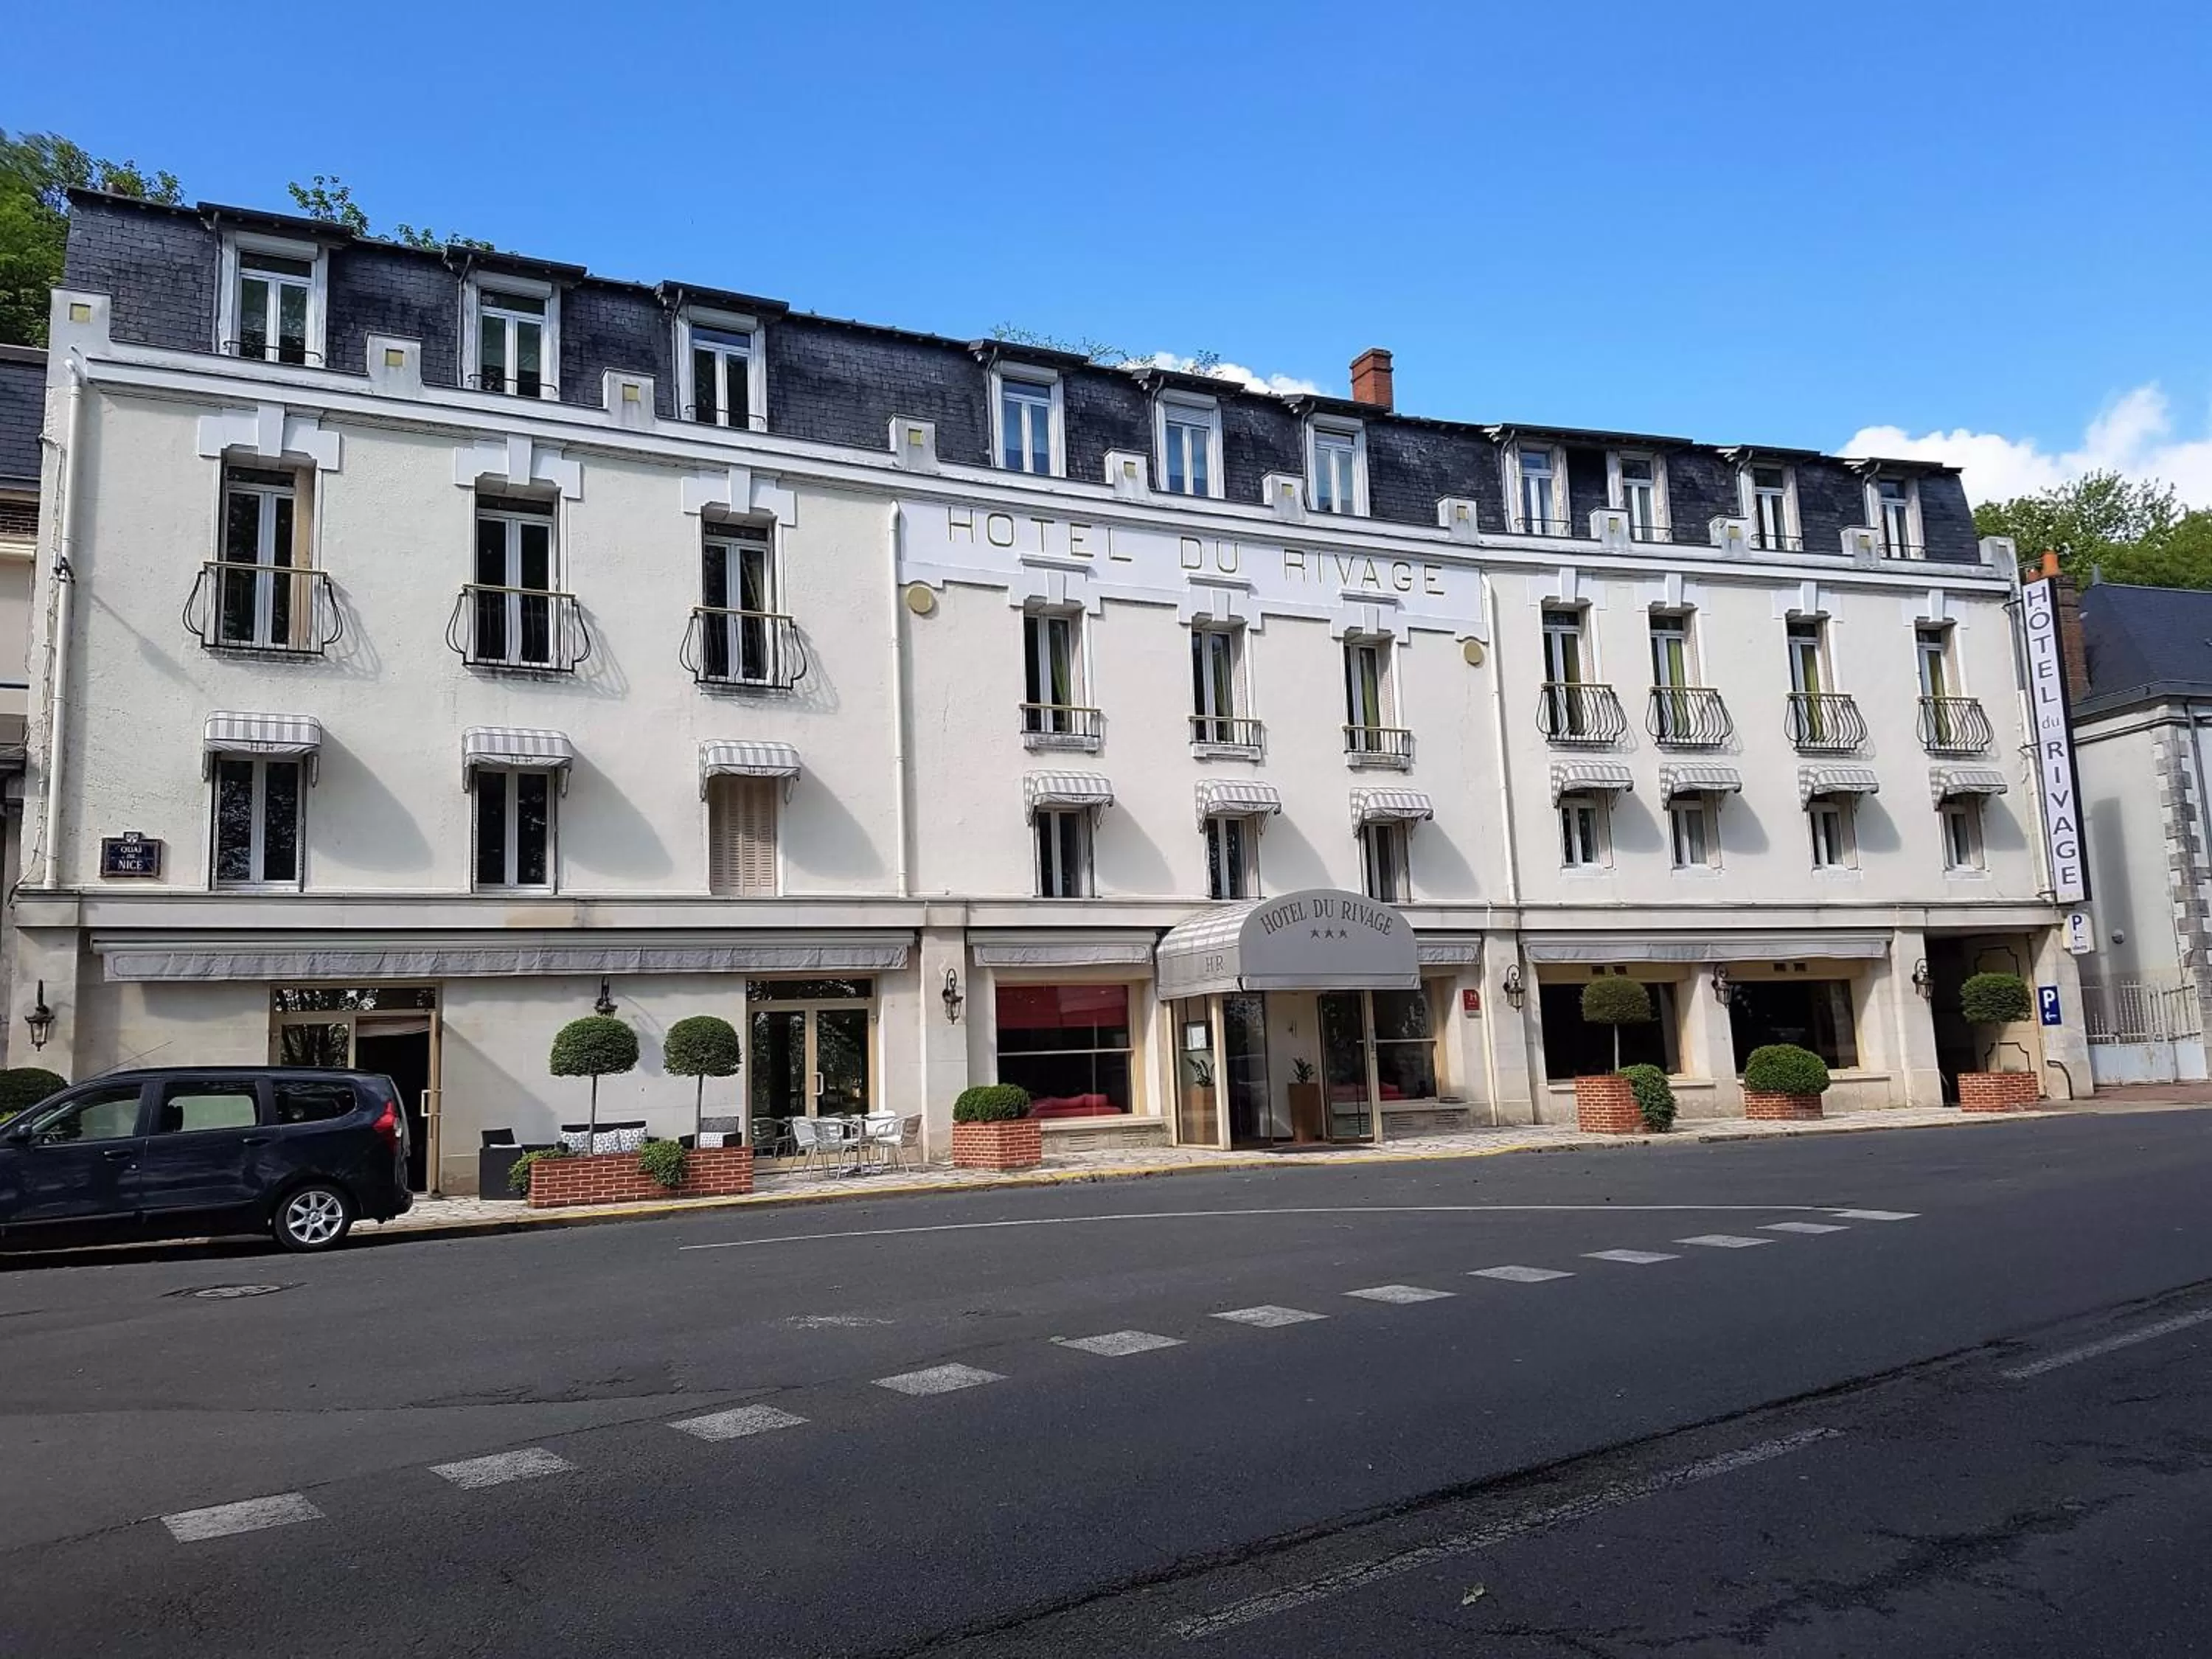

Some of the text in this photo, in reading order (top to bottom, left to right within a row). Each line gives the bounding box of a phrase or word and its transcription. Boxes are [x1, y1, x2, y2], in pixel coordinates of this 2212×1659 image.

[947, 506, 1446, 596] HOTEL DU RIVAGE
[2026, 586, 2078, 886] HÔTEL du RIVAGE
[120, 845, 142, 853] QUAI
[118, 859, 144, 869] NICE
[1260, 898, 1394, 936] HOTEL DU RIVAGE
[2072, 915, 2082, 931] P
[2042, 990, 2056, 1009] P
